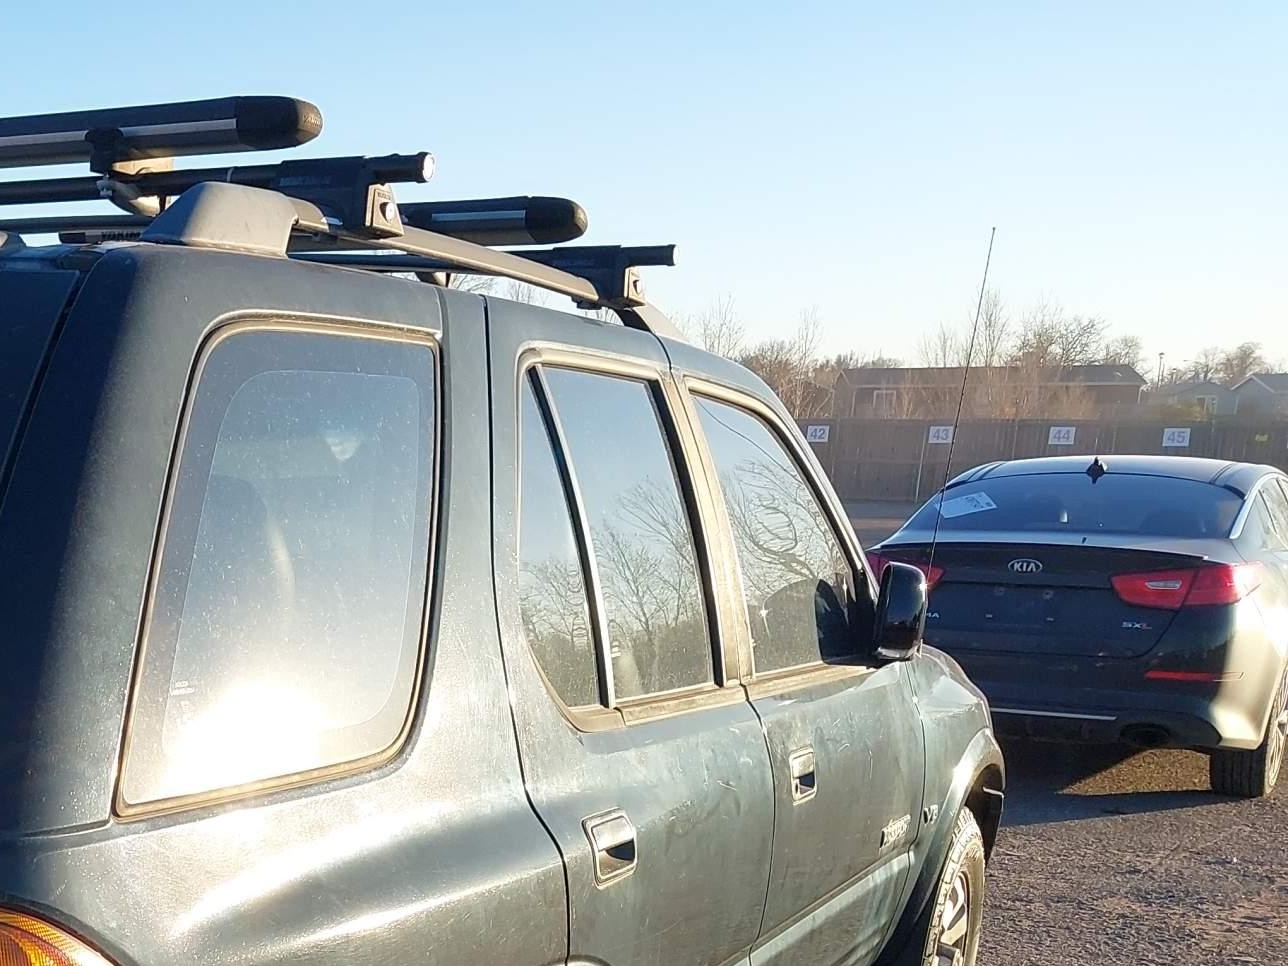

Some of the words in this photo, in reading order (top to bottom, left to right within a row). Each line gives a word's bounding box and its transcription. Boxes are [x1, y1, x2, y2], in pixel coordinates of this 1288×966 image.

[809, 428, 826, 440] 42
[932, 428, 949, 441] 43
[1052, 429, 1071, 442] 44
[1166, 430, 1186, 443] 45
